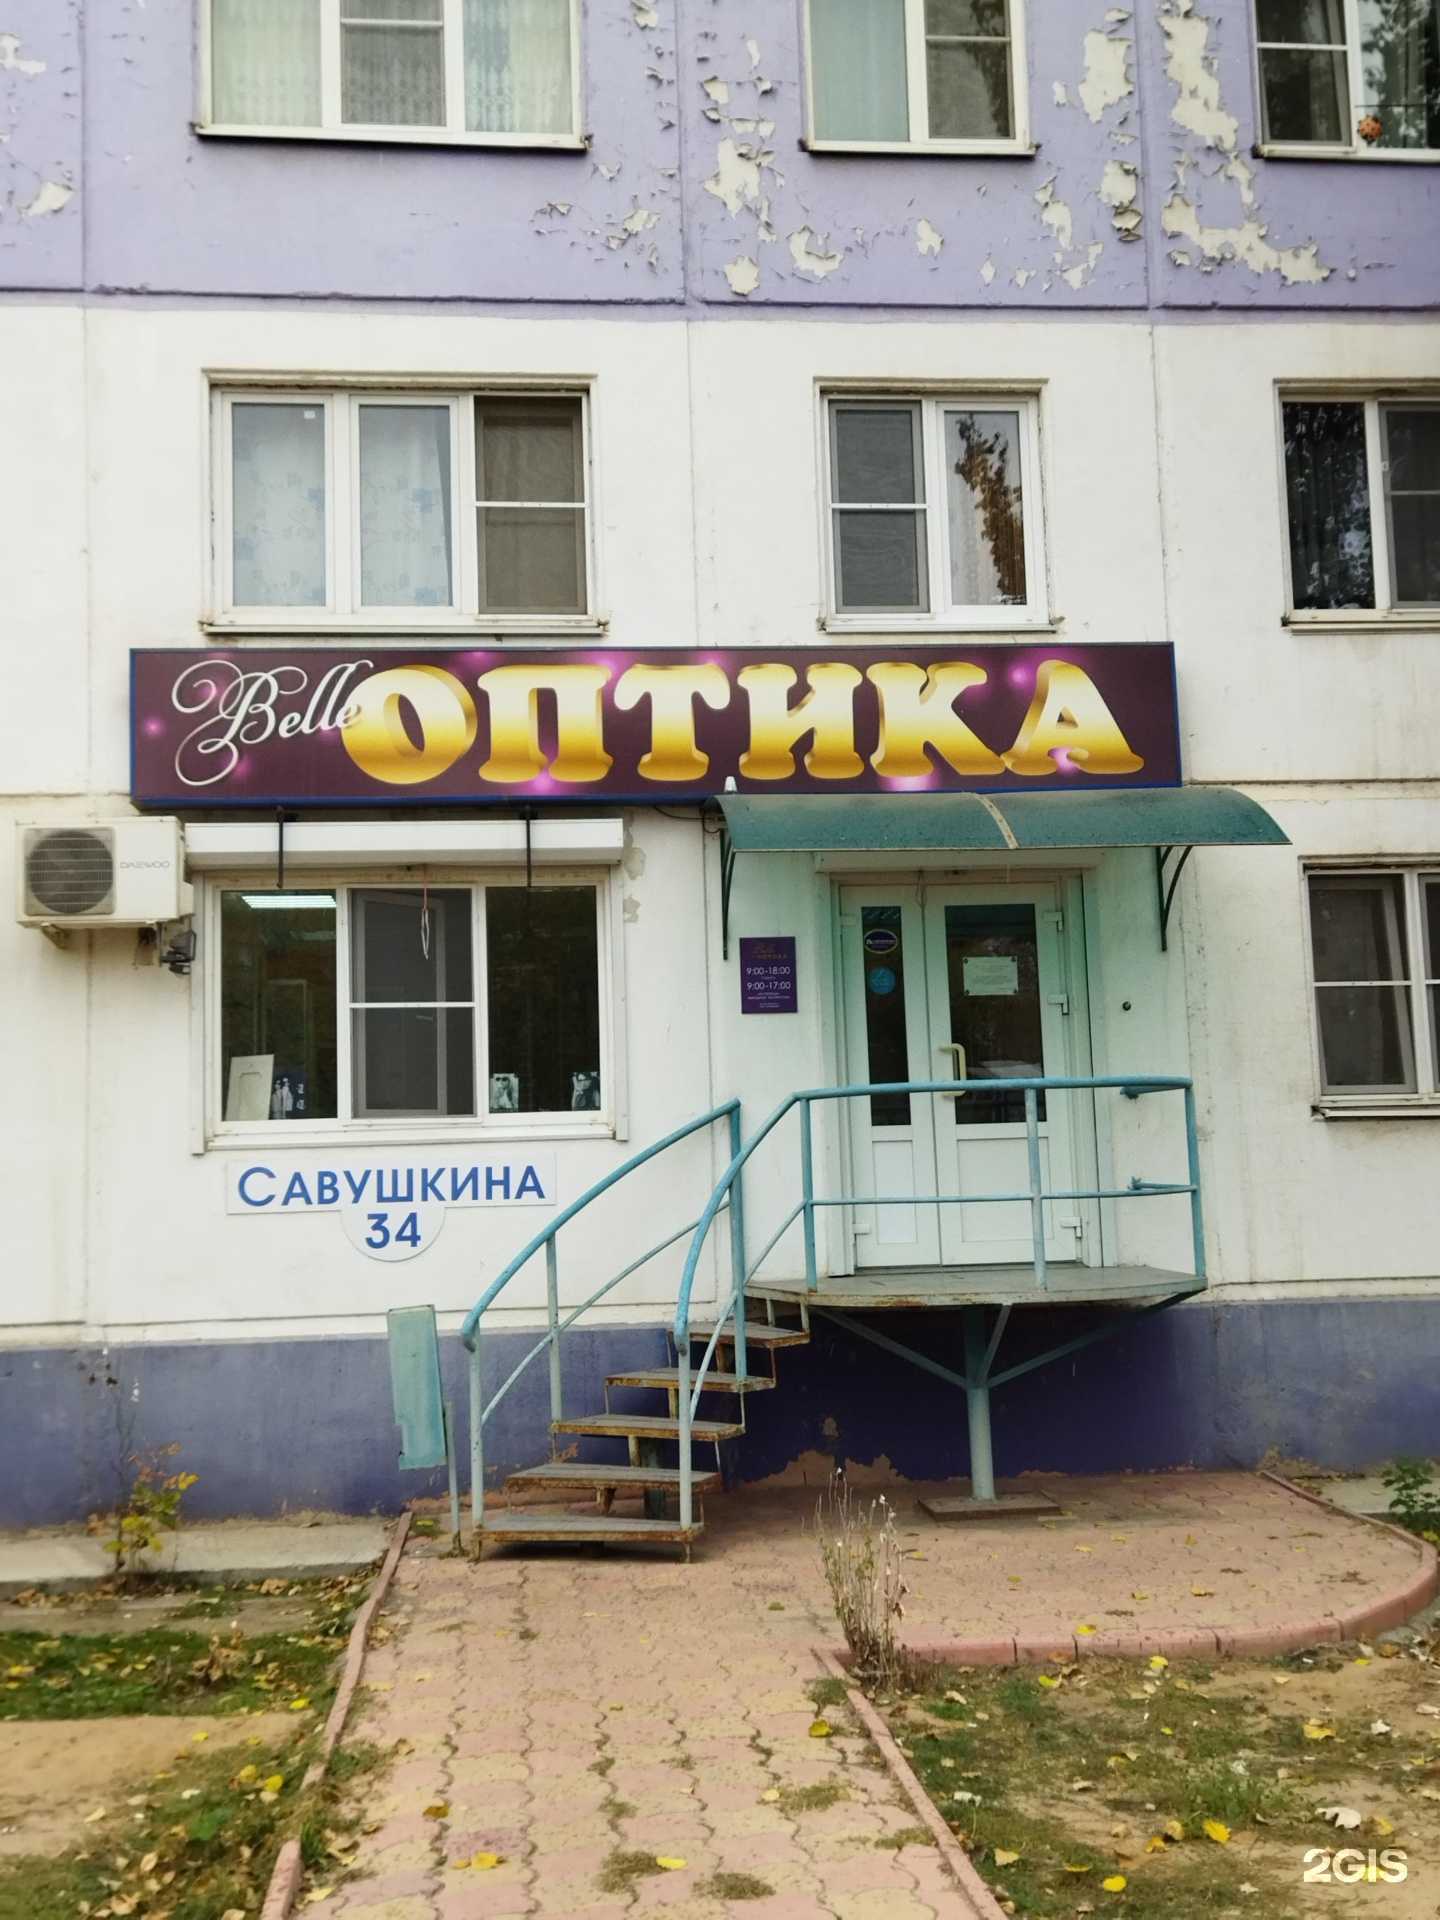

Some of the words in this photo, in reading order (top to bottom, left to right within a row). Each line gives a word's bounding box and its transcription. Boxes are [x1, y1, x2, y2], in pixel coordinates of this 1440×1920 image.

[171, 659, 374, 786] Belle
[341, 659, 1144, 785] ОПТИКА
[237, 1164, 546, 1207] САВУШКИНА
[364, 1211, 421, 1249] 34
